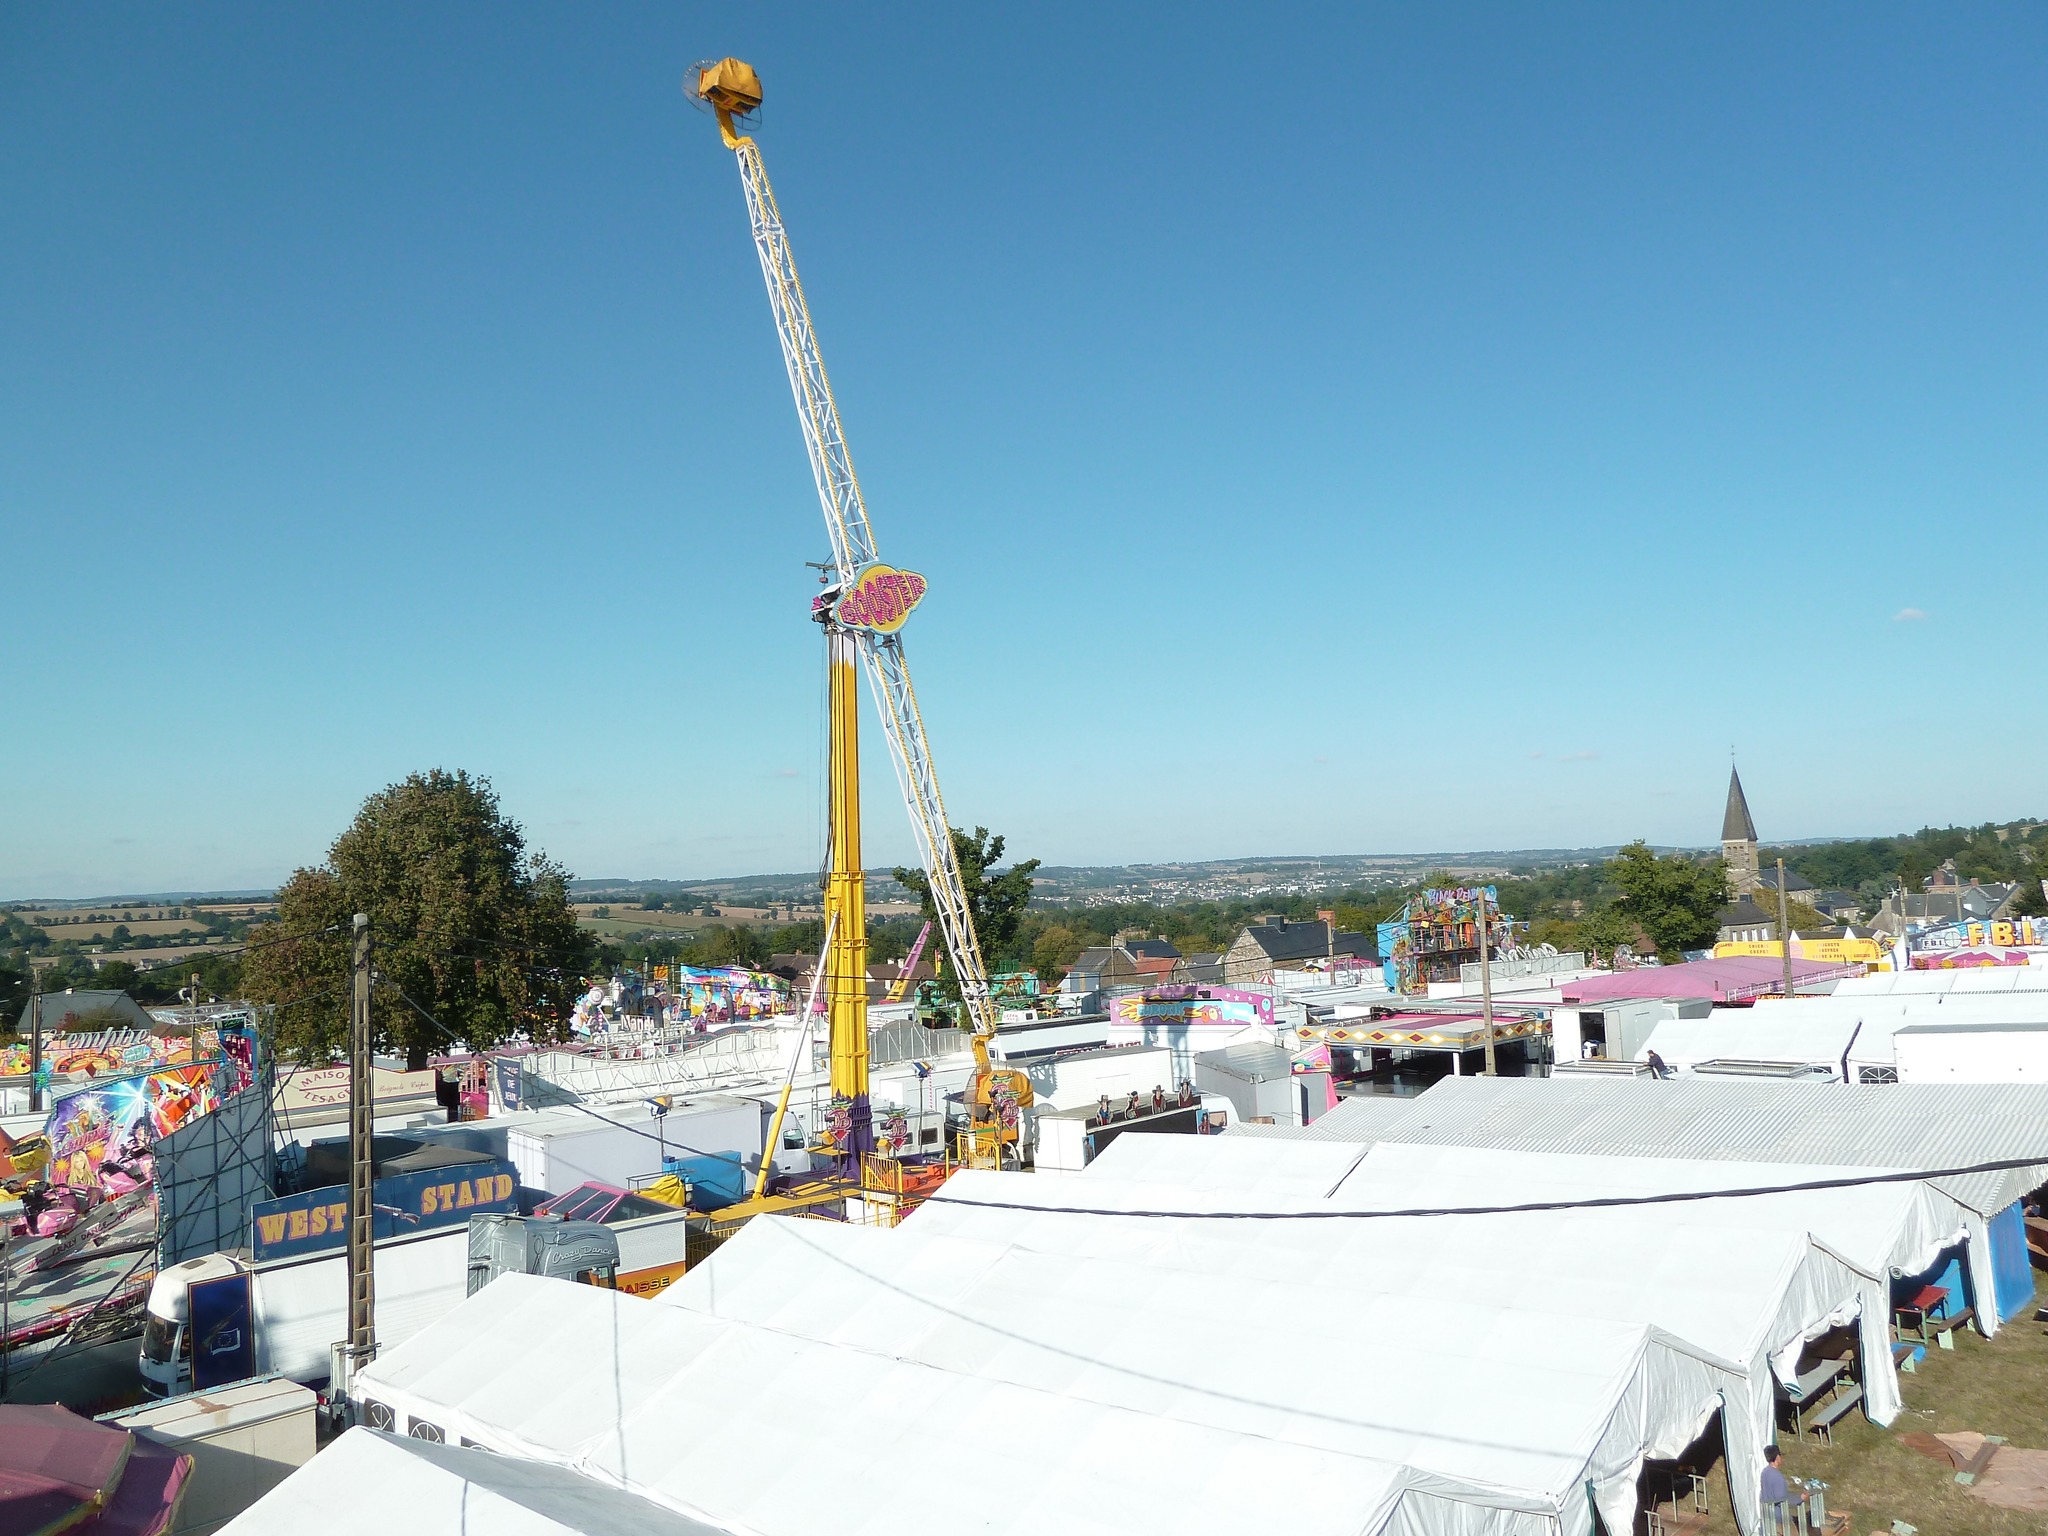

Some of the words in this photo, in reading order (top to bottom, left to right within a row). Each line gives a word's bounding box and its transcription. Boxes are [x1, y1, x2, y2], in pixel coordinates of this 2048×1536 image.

[839, 574, 926, 626] BOOSTER
[303, 1087, 351, 1103] LESAGE
[257, 1202, 348, 1246] WEST
[420, 1172, 514, 1215] STAND
[52, 1237, 78, 1256] CRAZY
[80, 1221, 108, 1241] DANCE
[552, 1248, 582, 1264] Crazy
[582, 1245, 615, 1257] Dance
